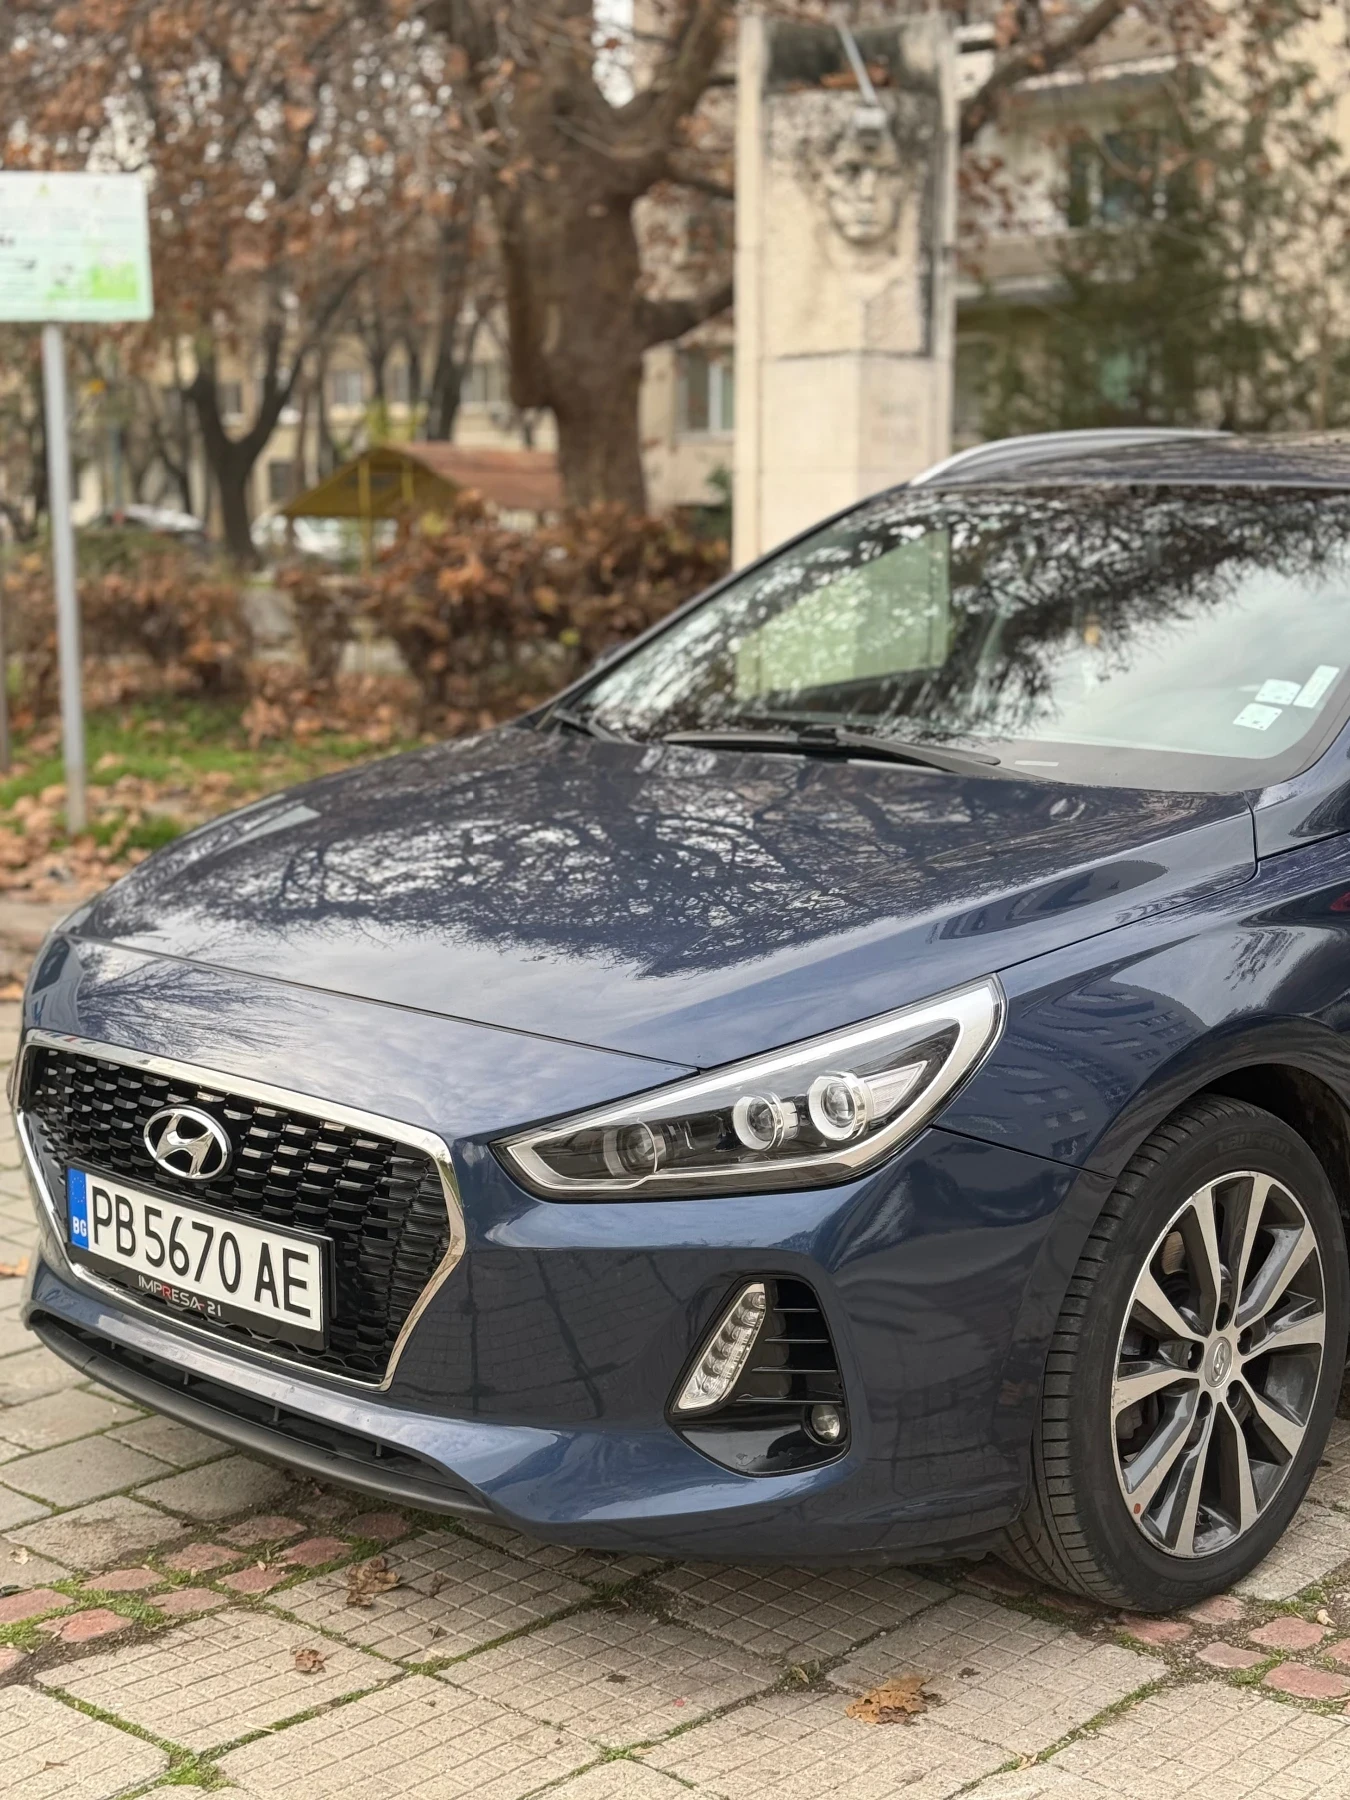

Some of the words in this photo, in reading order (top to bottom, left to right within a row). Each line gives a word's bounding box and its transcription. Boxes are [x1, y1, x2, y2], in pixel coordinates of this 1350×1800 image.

[72, 1215, 87, 1237] BG
[92, 1185, 137, 1258] PB
[144, 1205, 242, 1293] 5670
[254, 1242, 312, 1318] AE
